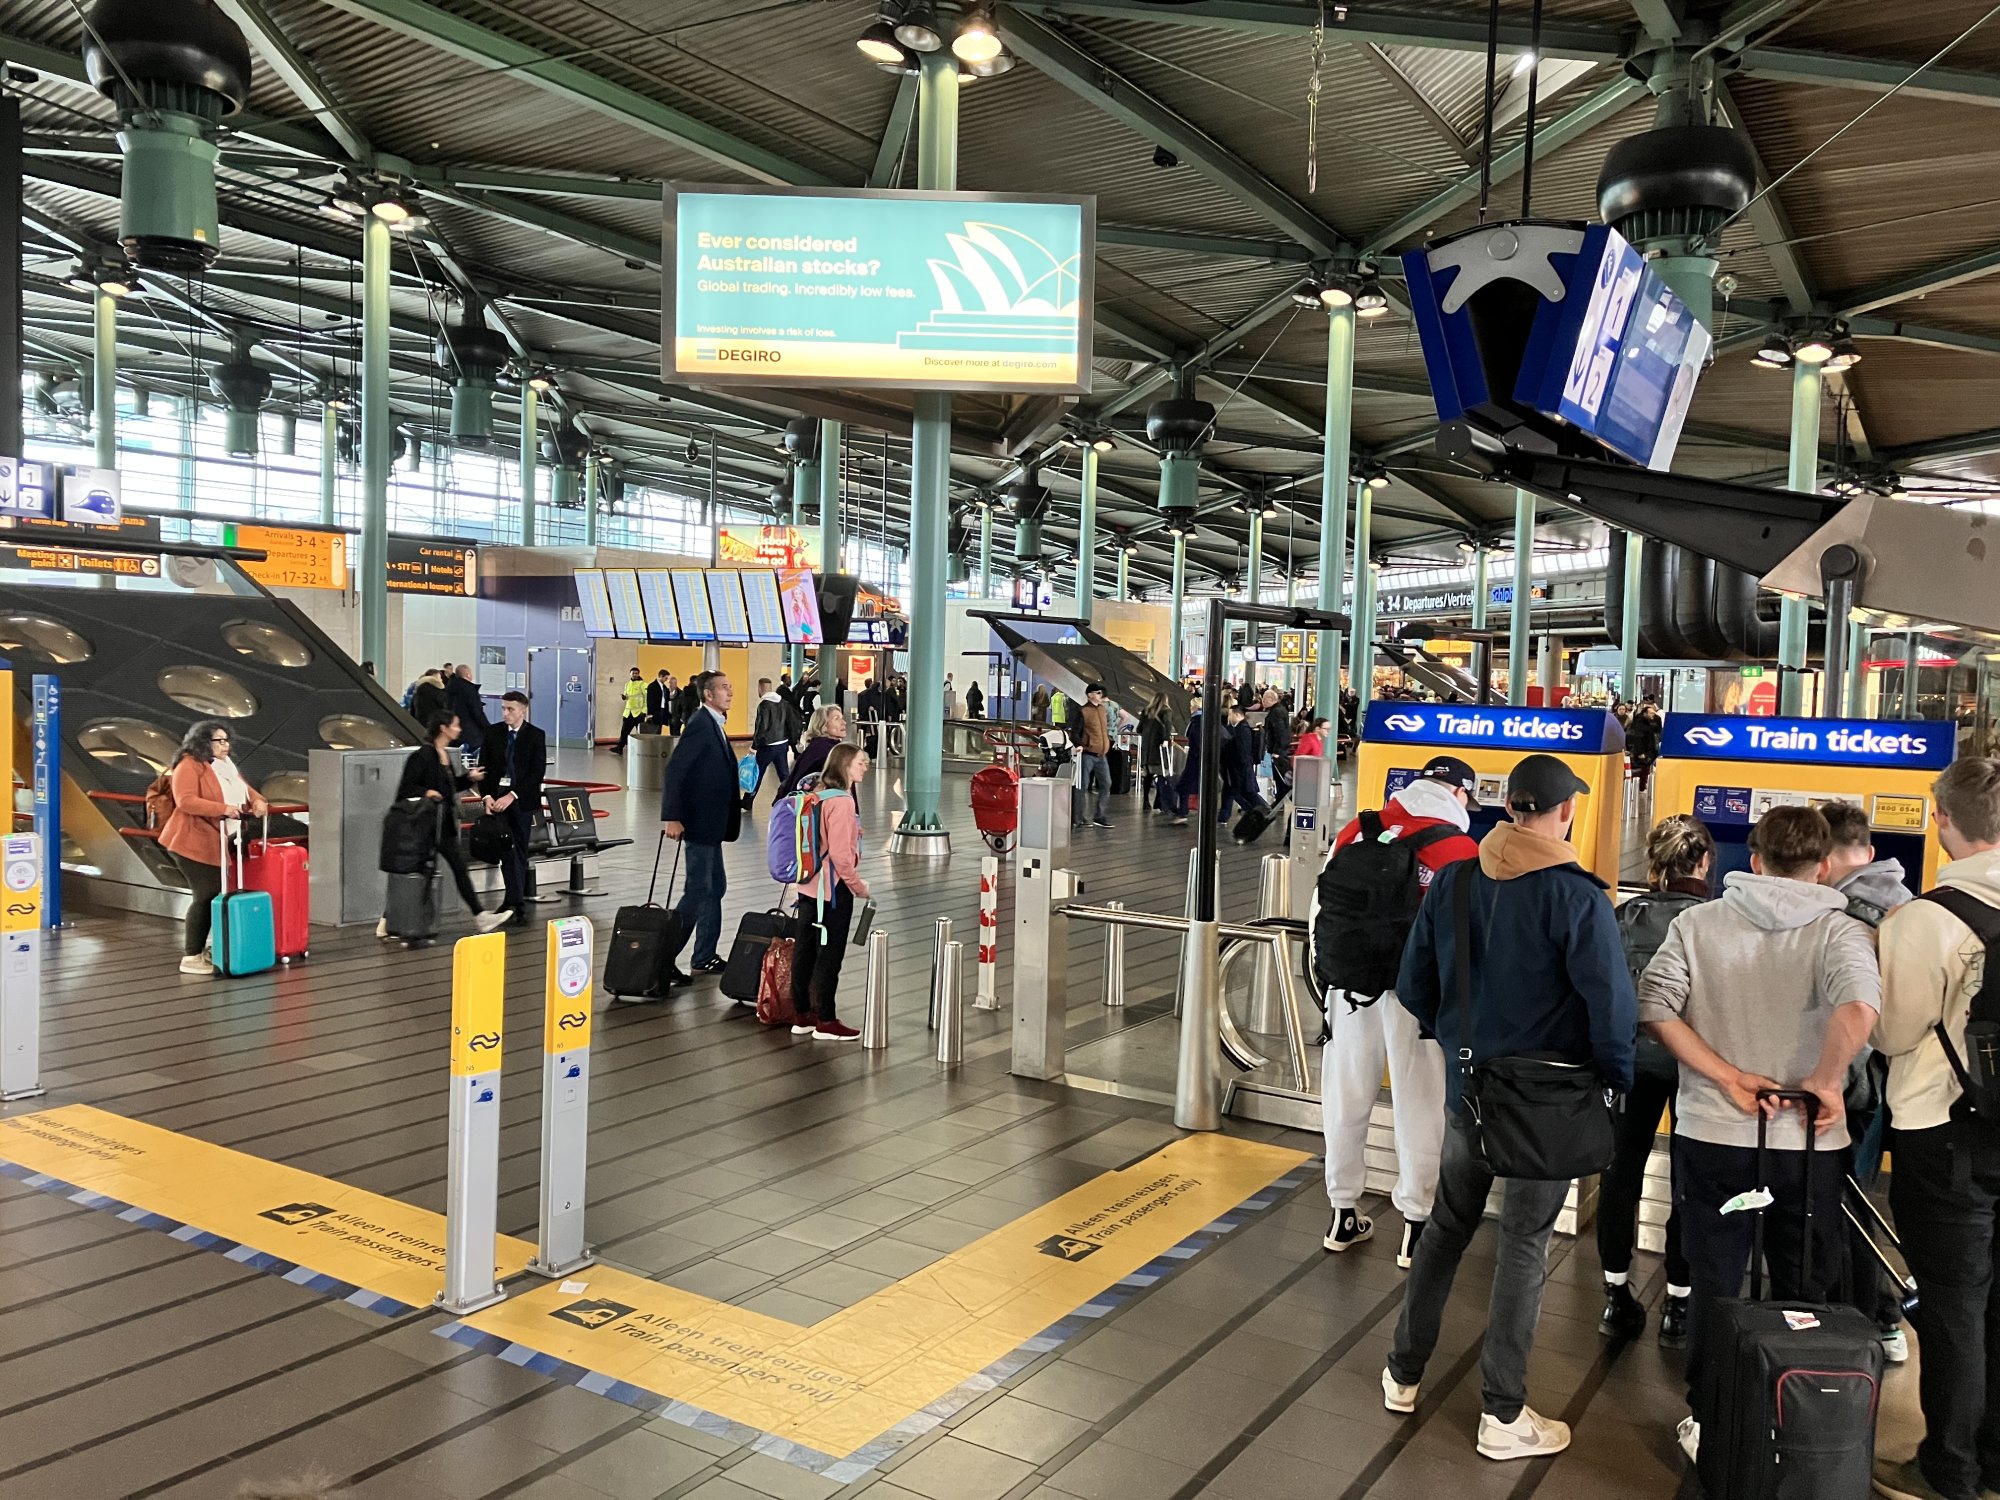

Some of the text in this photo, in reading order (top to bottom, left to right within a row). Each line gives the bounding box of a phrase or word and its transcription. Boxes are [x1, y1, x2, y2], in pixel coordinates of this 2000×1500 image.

[697, 231, 857, 254] Ever considered
[697, 255, 880, 277] Australian stocks?
[697, 279, 916, 299] Global trading. Incredibly low fees.
[1611, 296, 1623, 330] 1
[696, 324, 738, 336] Investing
[740, 325, 776, 336] involves
[787, 326, 802, 336] risk
[804, 327, 814, 336] of
[815, 328, 837, 338] loss.
[718, 348, 781, 363] DEGIRO
[924, 356, 1057, 371] Discover more at degiro.com
[1588, 370, 1601, 407] 2
[27, 471, 33, 483] 1
[26, 496, 34, 507] 2
[121, 517, 146, 526] rama
[264, 530, 294, 540] Arrivals
[295, 535, 317, 548] 3-4
[16, 549, 55, 561] Meeting
[267, 550, 308, 560] Departures
[309, 555, 317, 567] 3
[419, 547, 453, 557] Car rental
[759, 546, 785, 555] Here
[30, 559, 56, 568] point
[79, 557, 113, 569] Toilets
[431, 565, 453, 574] Hotels
[248, 570, 317, 585] Check-in 17-32
[386, 579, 453, 593] ternational lounge
[1387, 594, 1401, 612] 3-4
[1436, 714, 1583, 740] Train tickets
[1746, 725, 1927, 755] Train tickets
[26, 1114, 63, 1129] Alleen
[21, 1128, 89, 1152] passengers
[1064, 1172, 1180, 1236] Alleen treinreizigers
[1086, 1178, 1202, 1241] Train passengers only
[331, 1213, 386, 1234] Alleen
[308, 1220, 437, 1268] Train passengers
[634, 1313, 868, 1391] Alleen treinreizigers
[613, 1322, 843, 1403] Train passengers only
